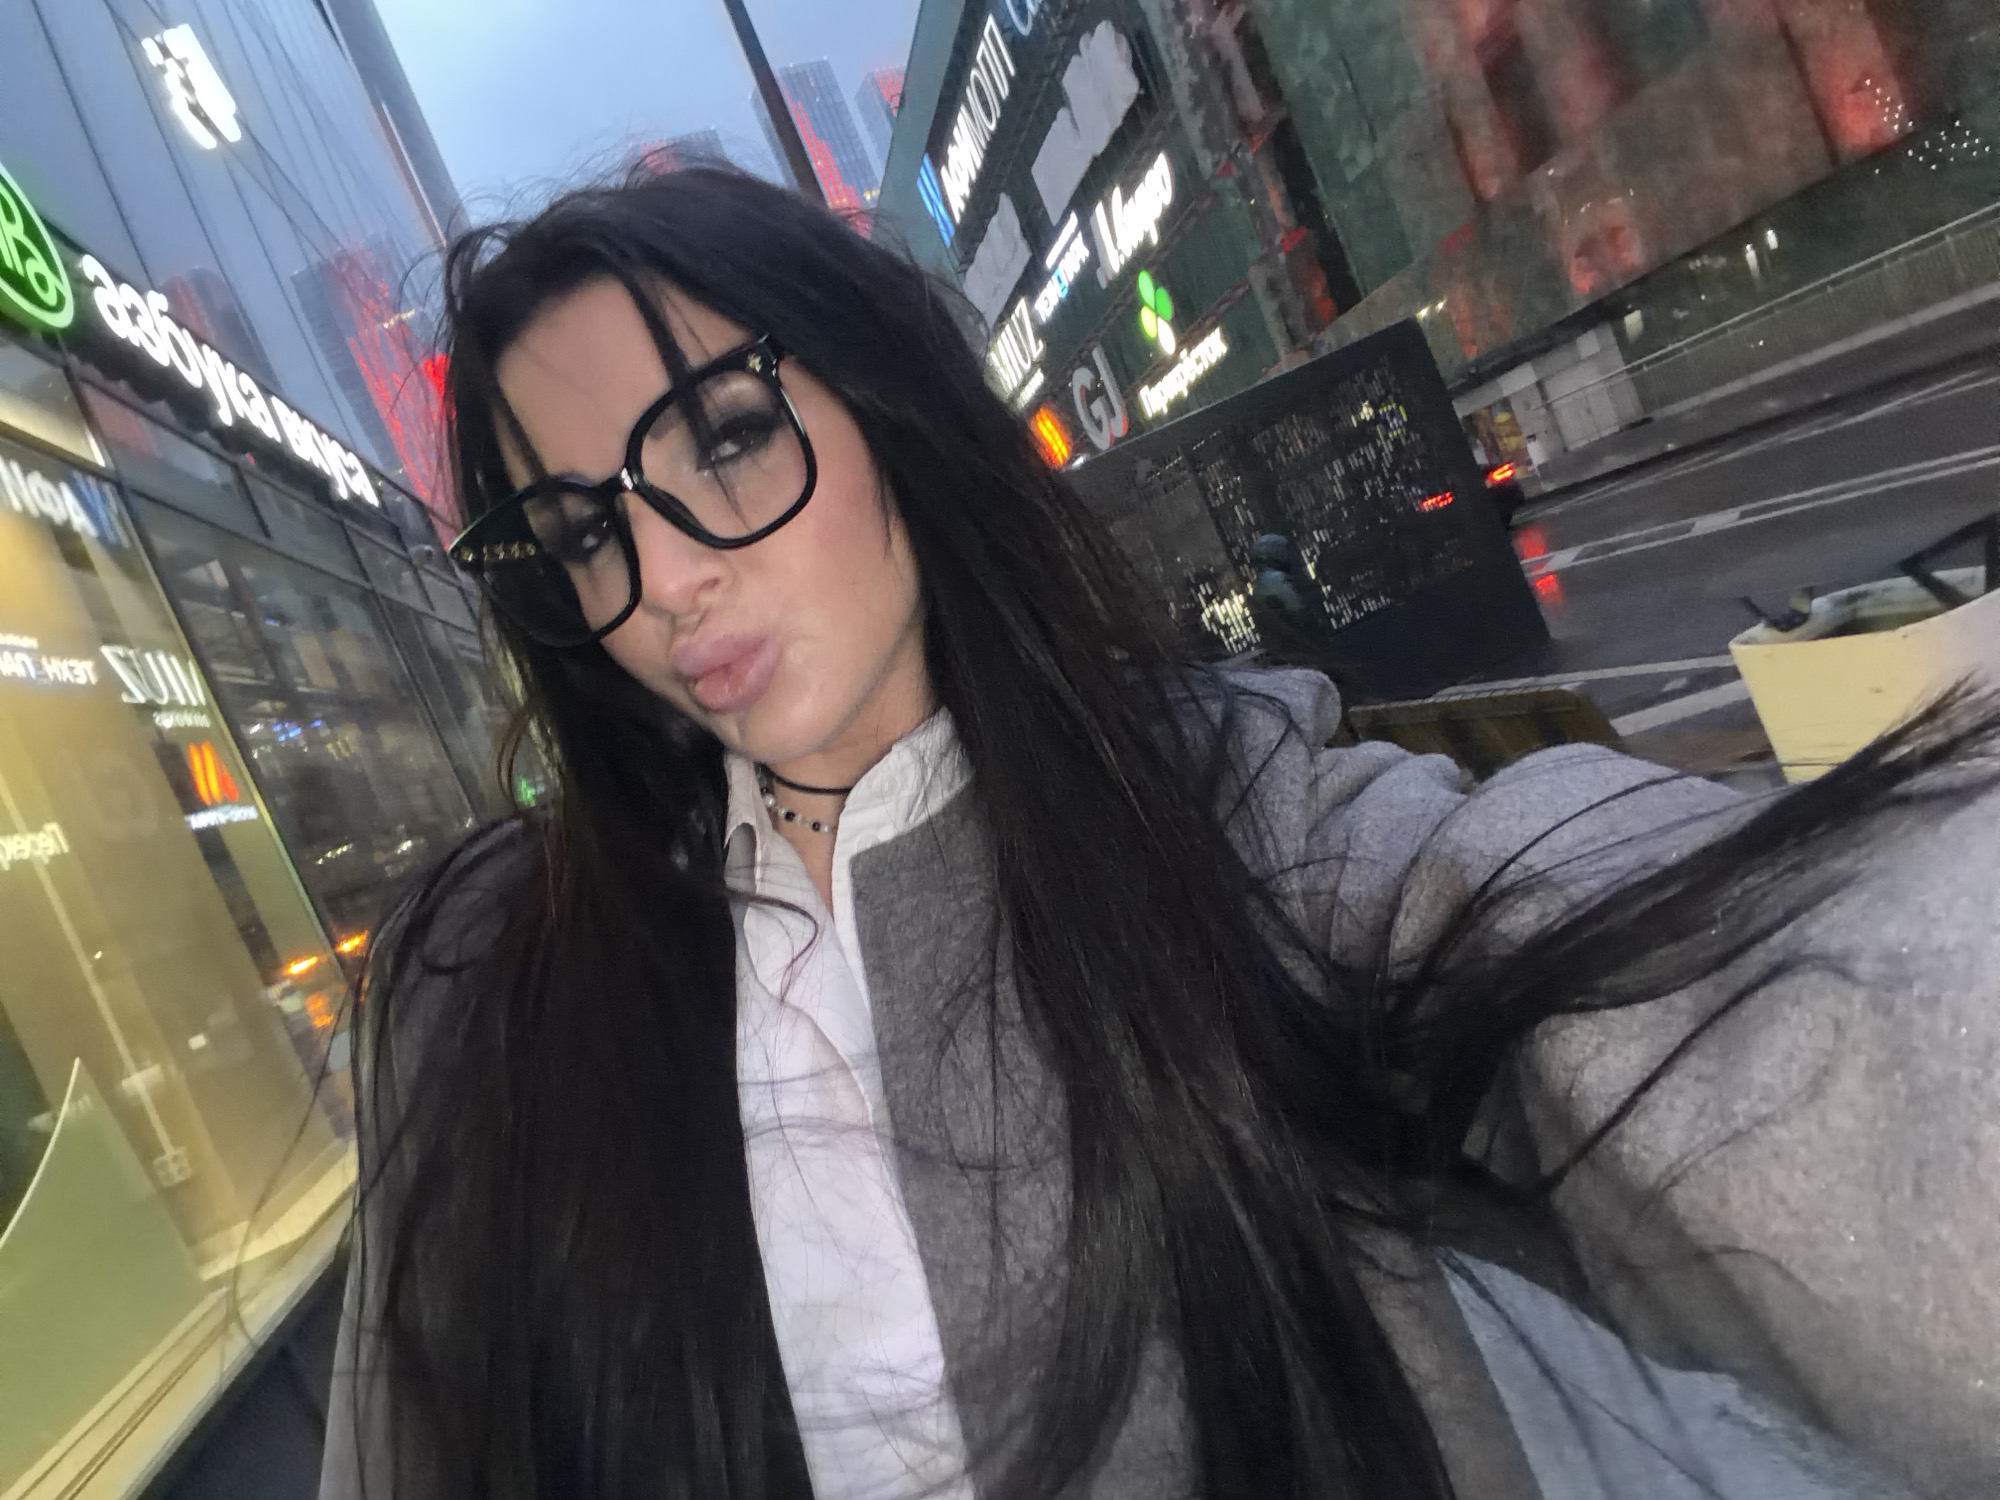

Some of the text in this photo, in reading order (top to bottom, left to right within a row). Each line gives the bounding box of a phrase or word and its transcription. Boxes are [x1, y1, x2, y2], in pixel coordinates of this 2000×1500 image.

[941, 14, 1015, 224] АФИМОЛЛ
[82, 254, 379, 507] азбука вкуса
